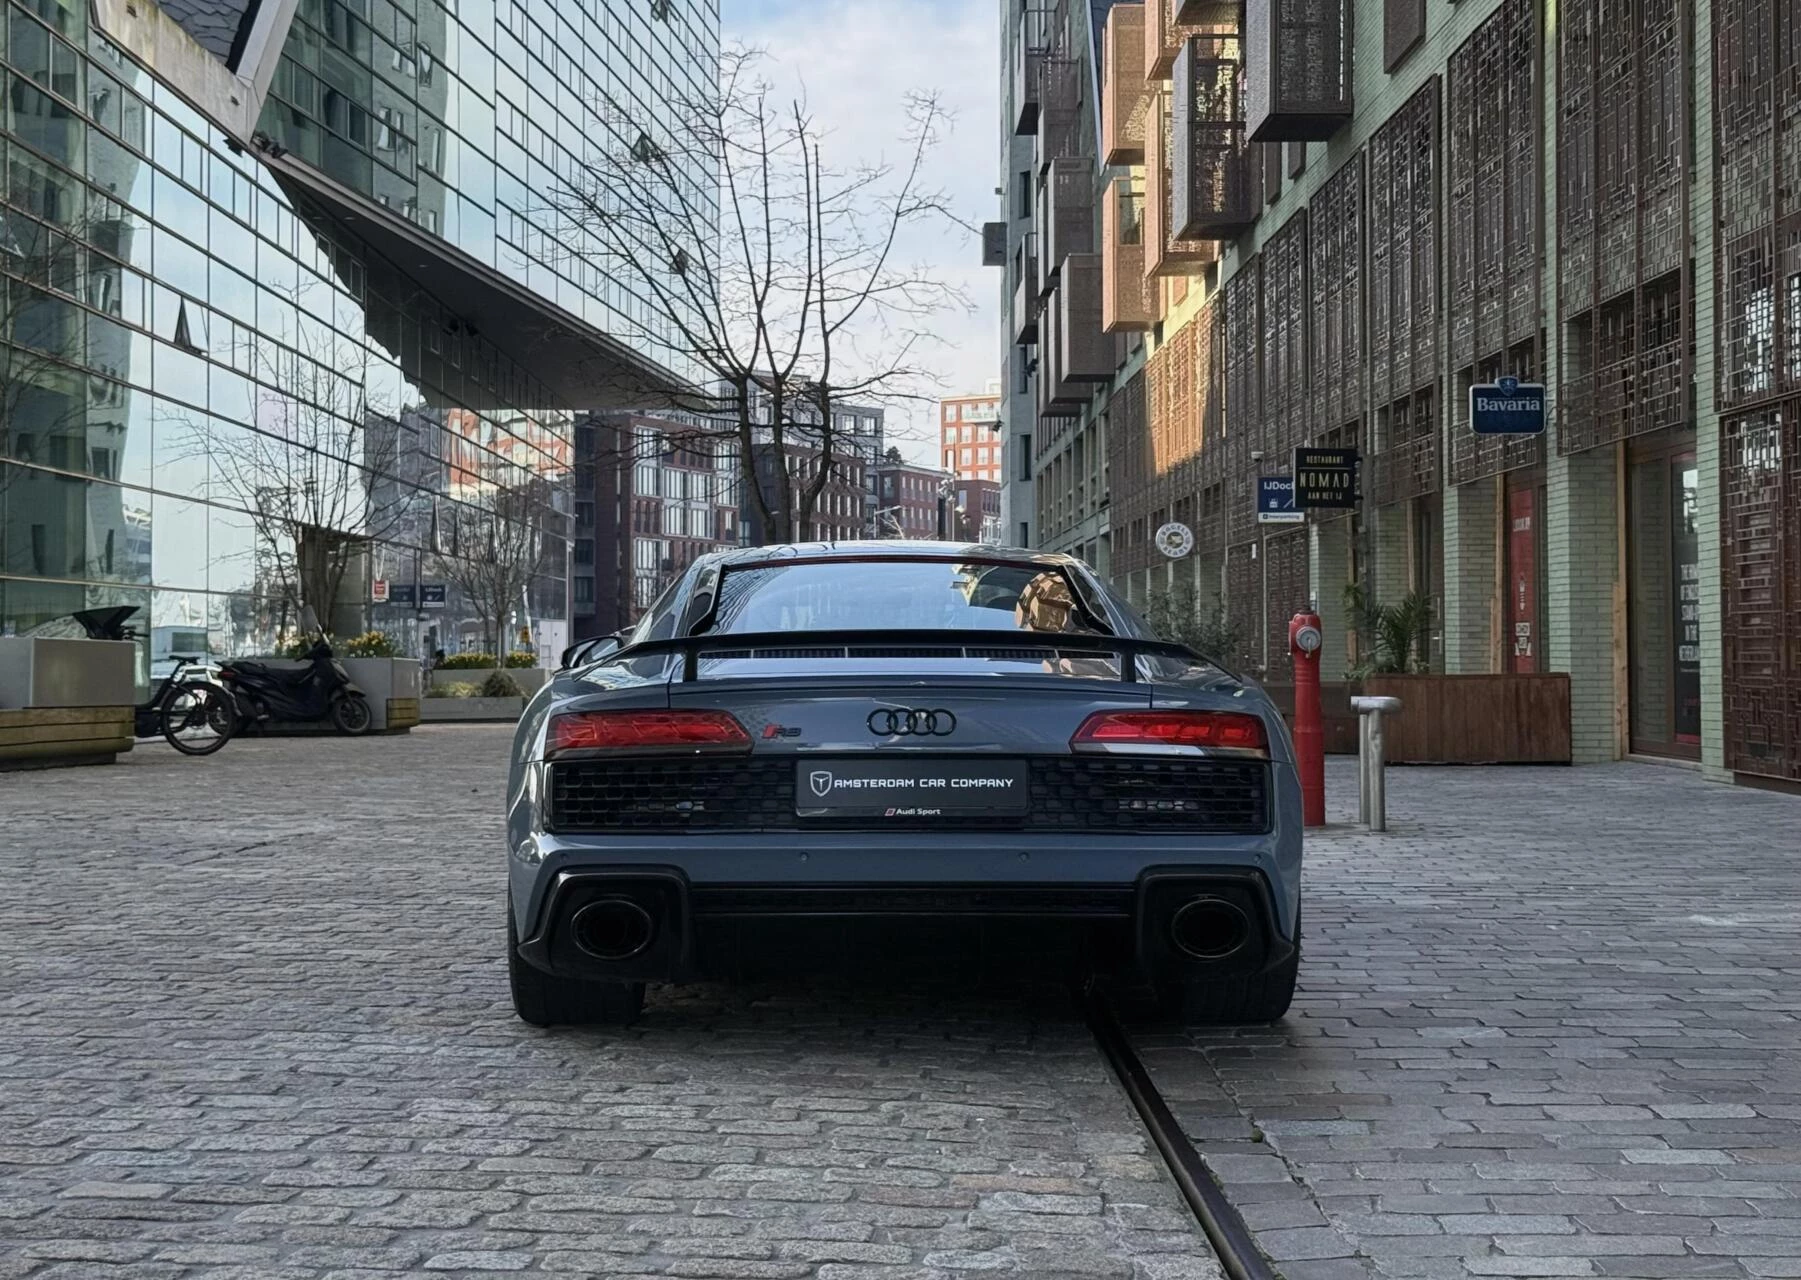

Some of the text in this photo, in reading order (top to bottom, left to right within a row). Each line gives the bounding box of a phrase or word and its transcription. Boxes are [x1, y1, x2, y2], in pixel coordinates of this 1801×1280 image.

[1476, 396, 1540, 412] Bavaria
[1306, 455, 1344, 464] RESTAURANT
[1299, 472, 1350, 488] NOMAD
[1307, 491, 1320, 500] AAN
[1322, 491, 1333, 500] HET
[834, 778, 1014, 788] AMSTERDAM CAR COMPANY
[916, 808, 941, 816] Sport
